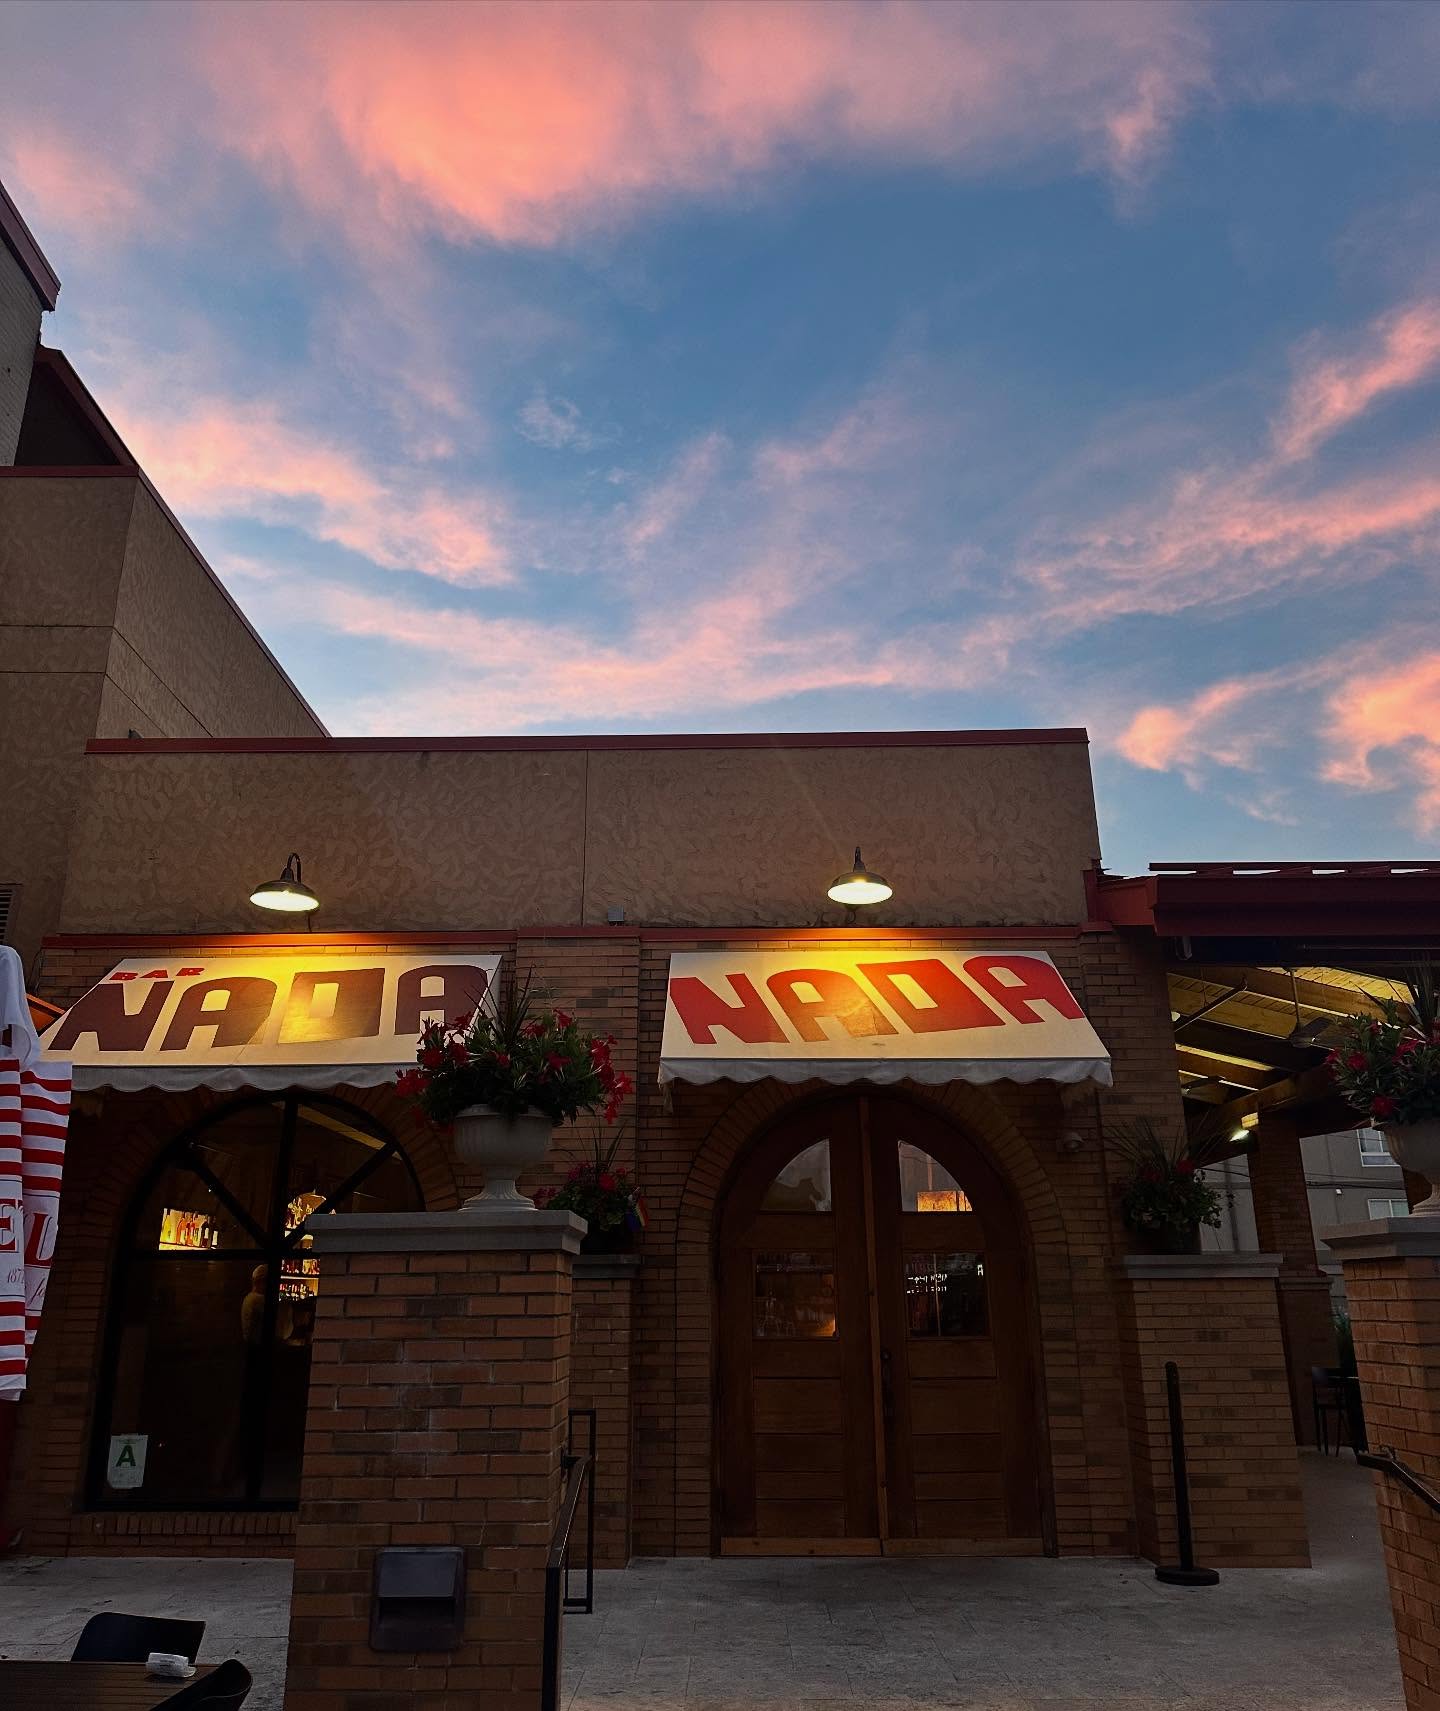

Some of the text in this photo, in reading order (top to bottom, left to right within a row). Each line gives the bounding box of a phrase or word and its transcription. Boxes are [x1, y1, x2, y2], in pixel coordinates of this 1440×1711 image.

[109, 967, 205, 981] BAR
[669, 955, 1086, 1044] NADA
[48, 965, 488, 1051] NADA
[115, 1444, 137, 1467] A
